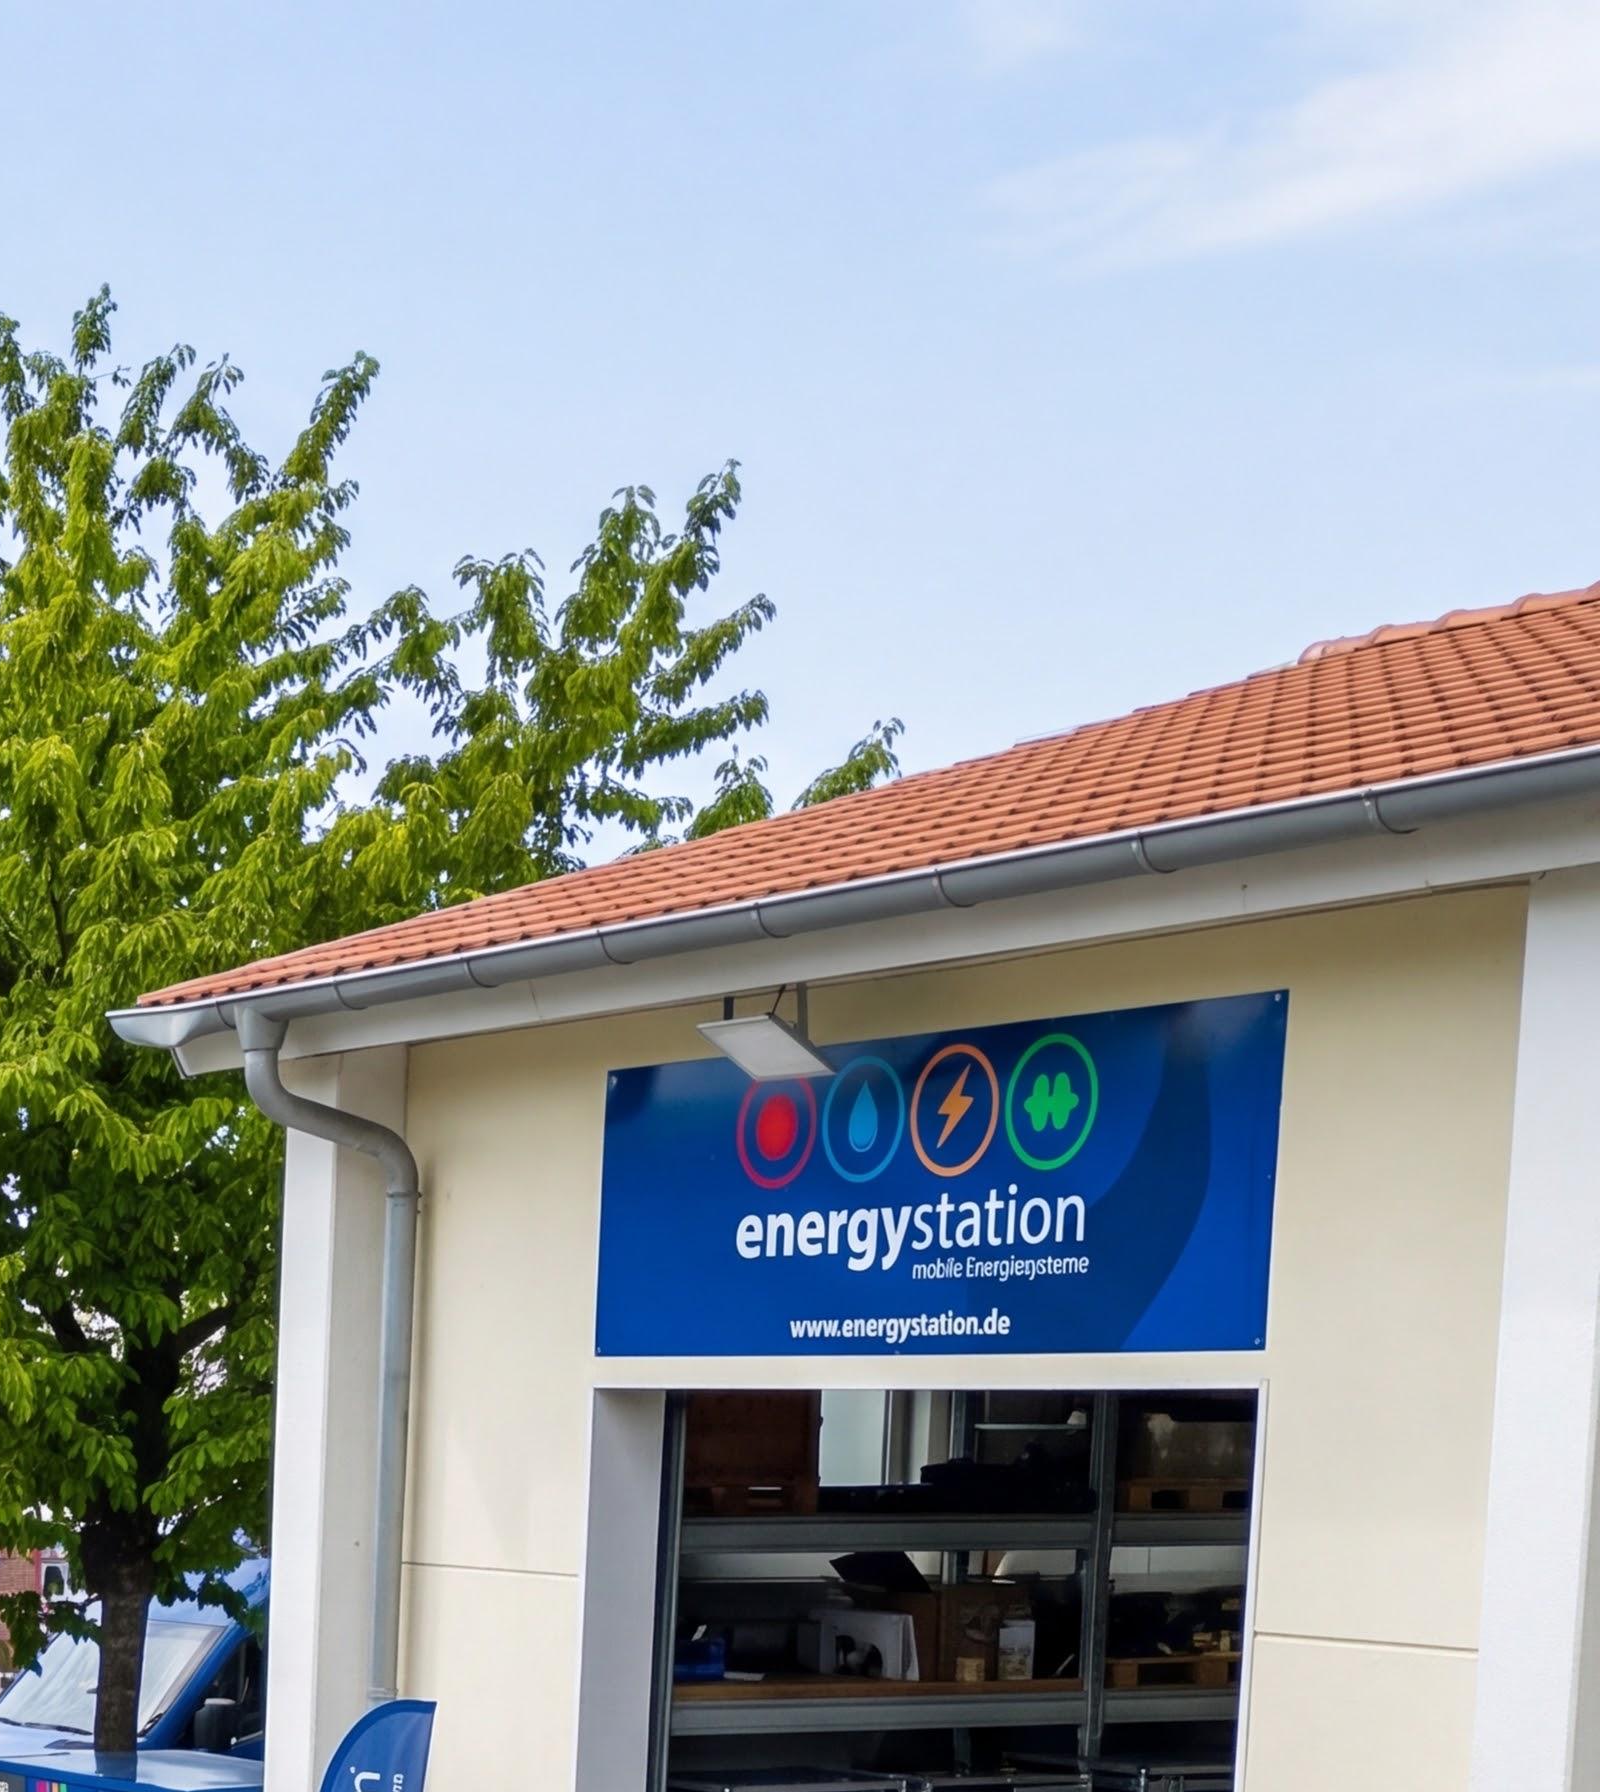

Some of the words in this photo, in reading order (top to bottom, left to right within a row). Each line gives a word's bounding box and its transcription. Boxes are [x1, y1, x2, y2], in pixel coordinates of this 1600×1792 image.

[736, 1184, 1086, 1272] energystation
[912, 1257, 963, 1280] mobile
[790, 1308, 1011, 1343] www.energystation.de
